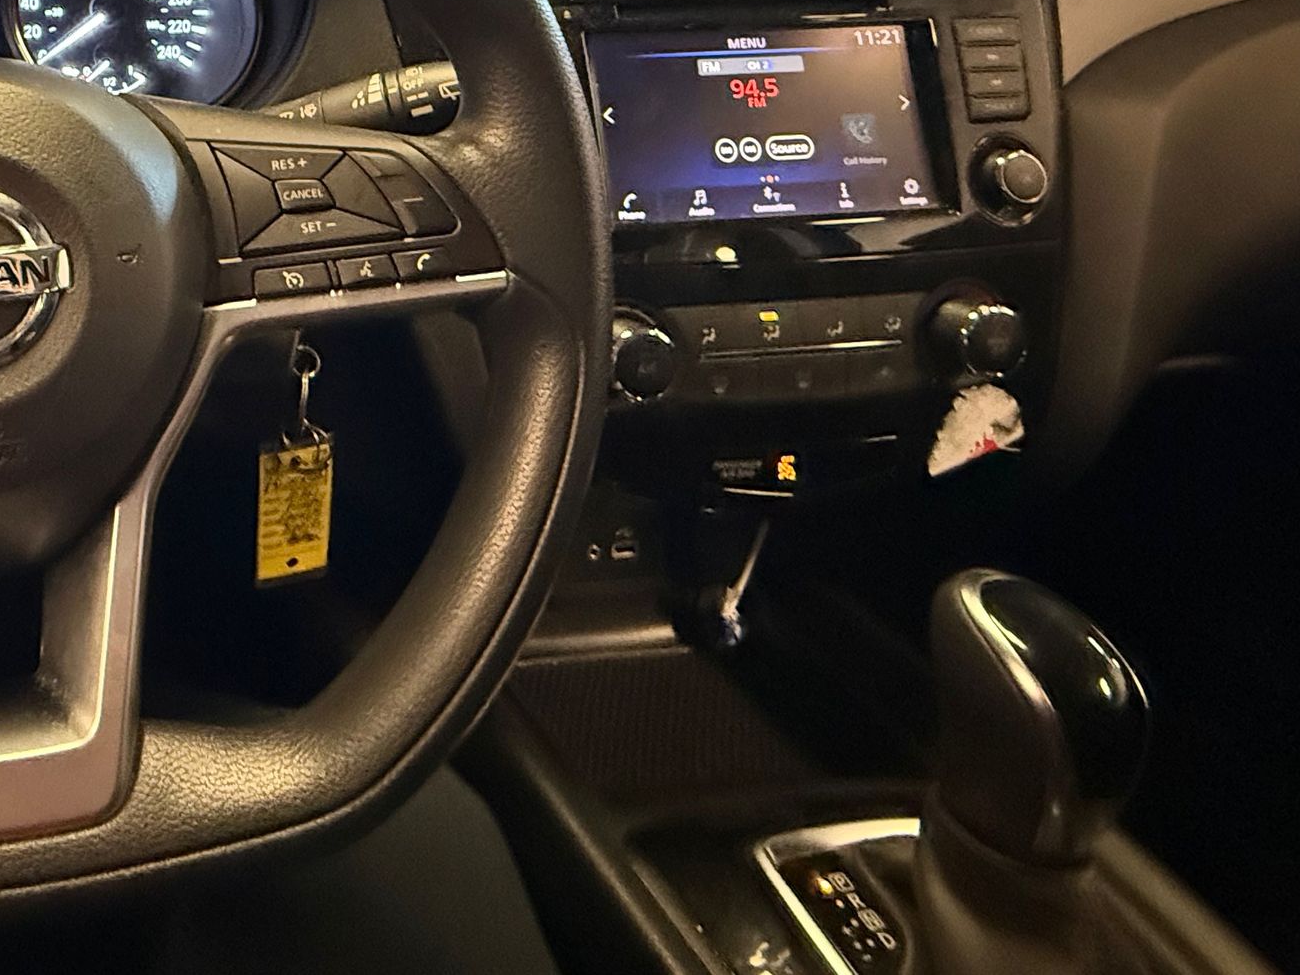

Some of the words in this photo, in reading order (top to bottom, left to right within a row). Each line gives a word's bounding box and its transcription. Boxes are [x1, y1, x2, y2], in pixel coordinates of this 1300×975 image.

[23, 23, 42, 40] 20
[167, 19, 192, 34] 220
[727, 37, 766, 49] MENU
[854, 29, 902, 46] 11:21
[156, 43, 182, 60] 240
[702, 61, 721, 73] FM
[402, 79, 424, 91] OFF
[730, 78, 779, 99] 94.5
[748, 97, 766, 108] FM
[770, 142, 810, 155] Source
[271, 158, 296, 172] RES
[282, 187, 325, 203] CANCEL
[300, 221, 322, 234] SET
[876, 931, 897, 951] D
